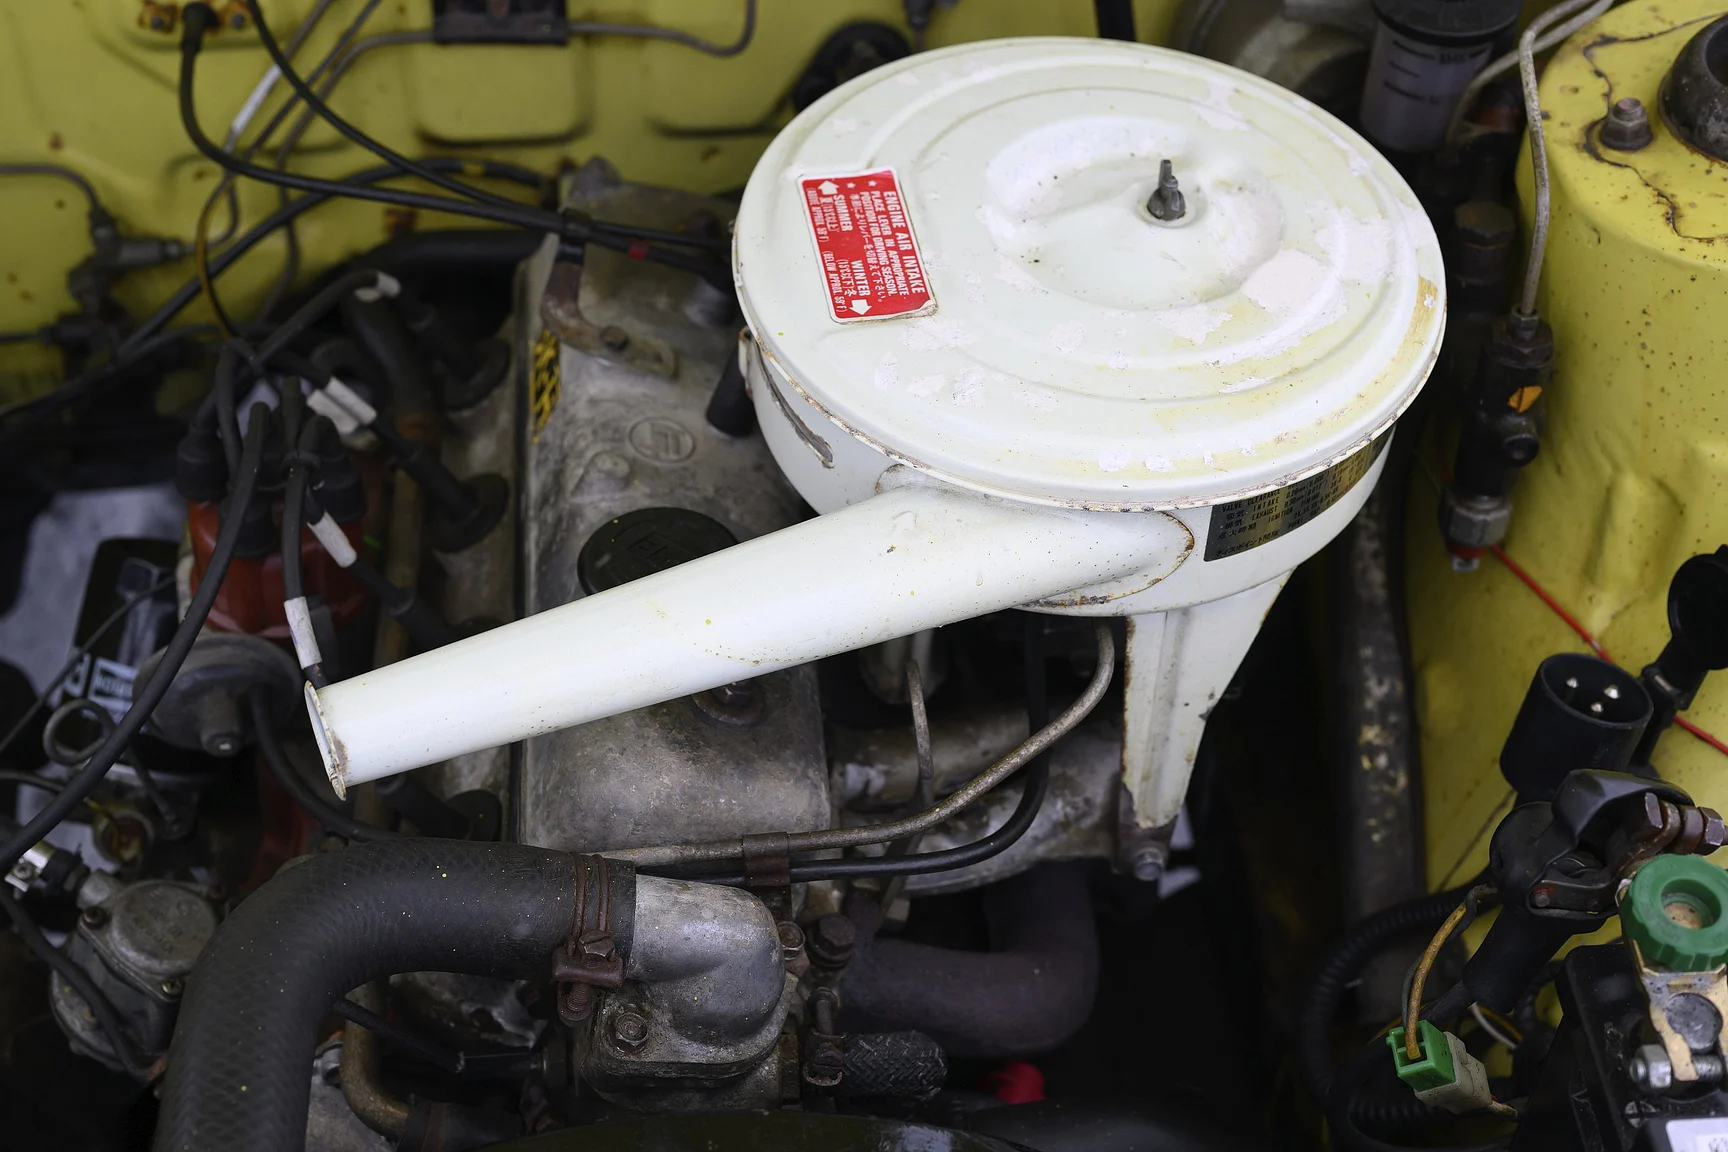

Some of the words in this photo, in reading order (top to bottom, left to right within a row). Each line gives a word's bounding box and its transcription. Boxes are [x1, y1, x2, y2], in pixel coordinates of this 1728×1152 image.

[806, 187, 820, 205] (ABOVE
[860, 191, 876, 222] POSITION
[870, 190, 885, 211] PLACE
[833, 194, 853, 231] SUMMER
[882, 190, 906, 228] ENGINE
[868, 222, 880, 236] FOR
[877, 214, 891, 235] LEVER
[872, 236, 888, 265] DRIVING
[884, 238, 895, 246] IN
[894, 231, 912, 250] AIR
[821, 250, 836, 272] (BELOW
[887, 249, 909, 295] APPROPRIATE
[850, 260, 870, 296] WINTER
[880, 266, 897, 296] SEASON.
[901, 255, 925, 293] INTAKE
[1222, 503, 1242, 513] VALVE
[1248, 490, 1281, 506] CLEARANCE
[1253, 497, 1279, 512] INTAKE
[1251, 506, 1278, 521] EXHAUST
[1267, 508, 1293, 523] IGNITION
